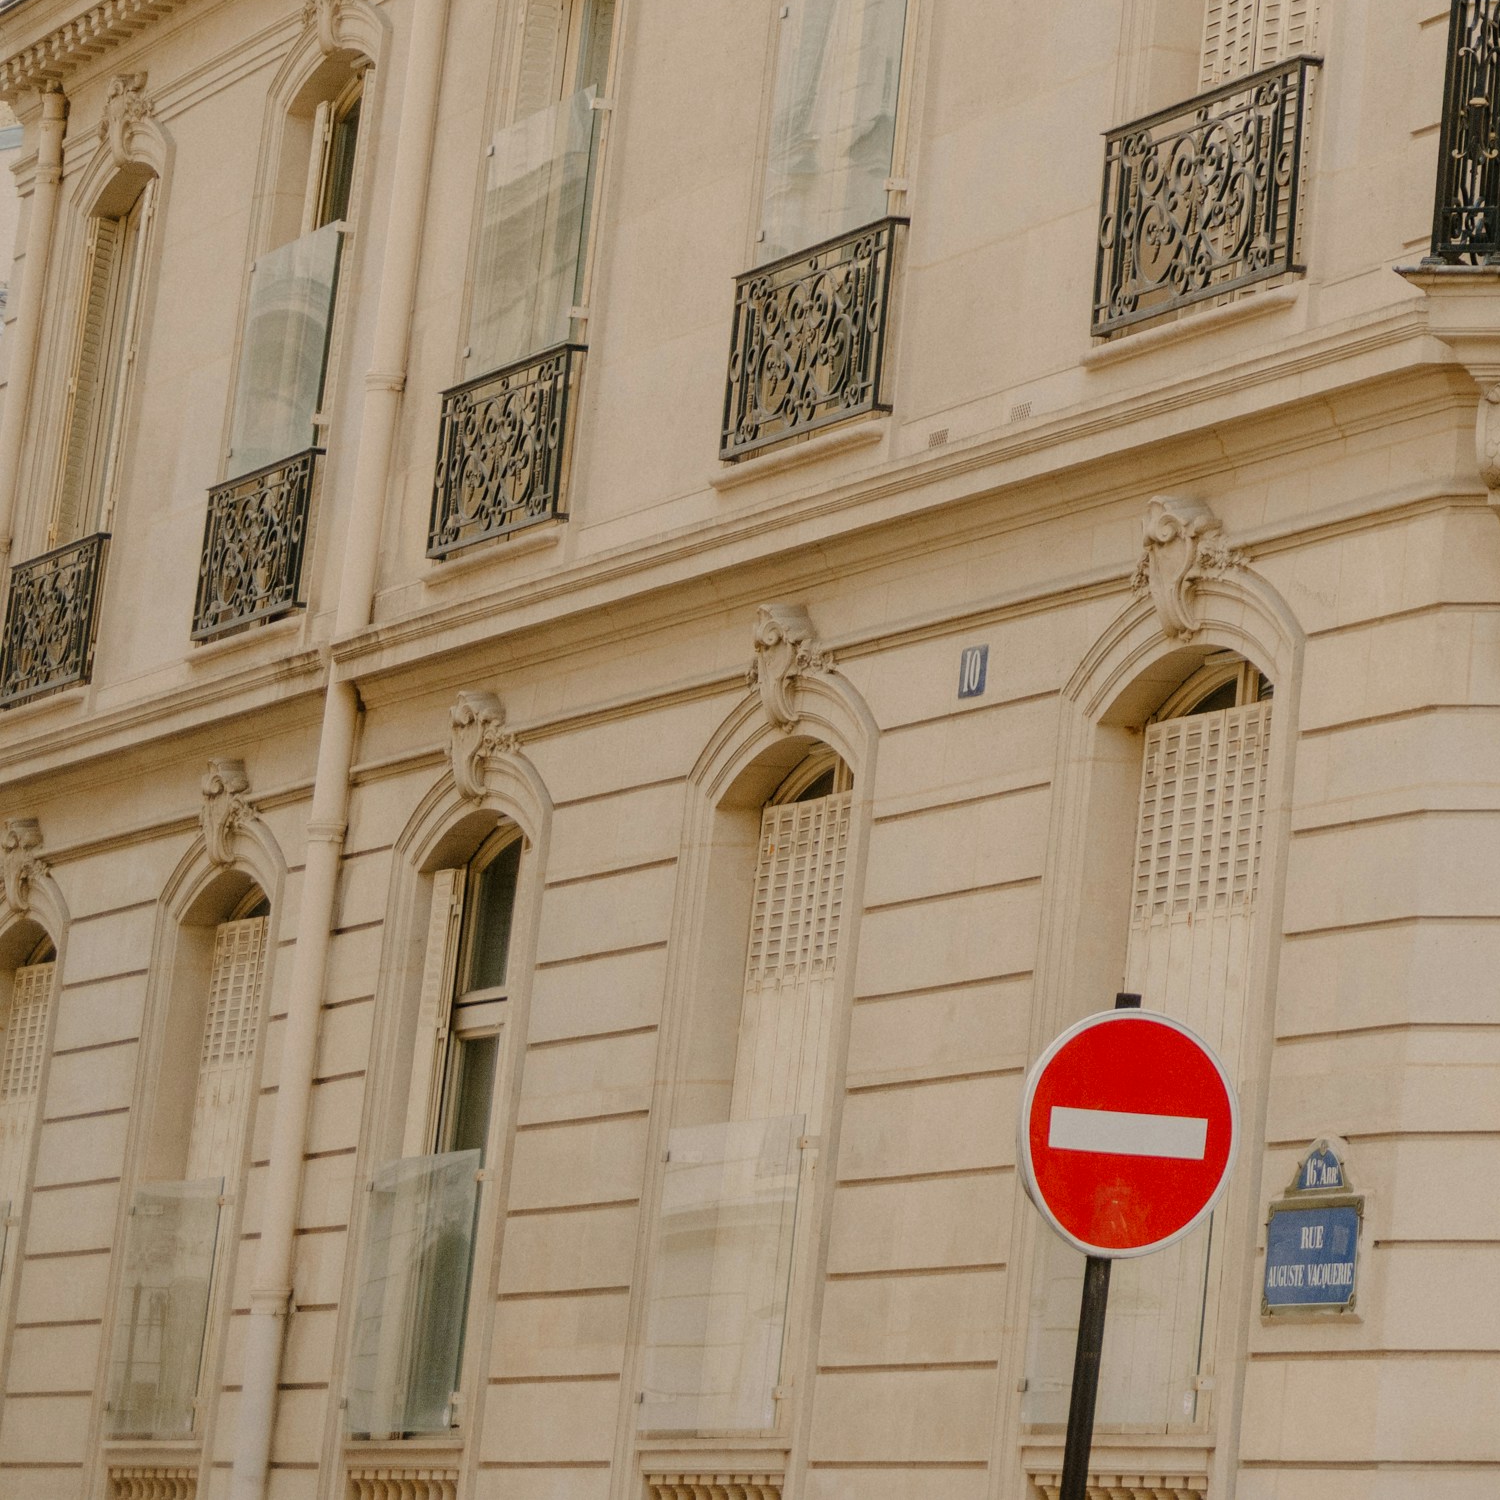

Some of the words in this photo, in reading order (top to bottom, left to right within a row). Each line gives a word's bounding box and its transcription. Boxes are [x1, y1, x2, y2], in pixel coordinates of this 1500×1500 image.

[962, 649, 981, 693] 10
[1301, 1226, 1323, 1248] RUE
[1268, 1265, 1304, 1287] AUGUSTE
[1308, 1263, 1353, 1288] VACQUERIE
